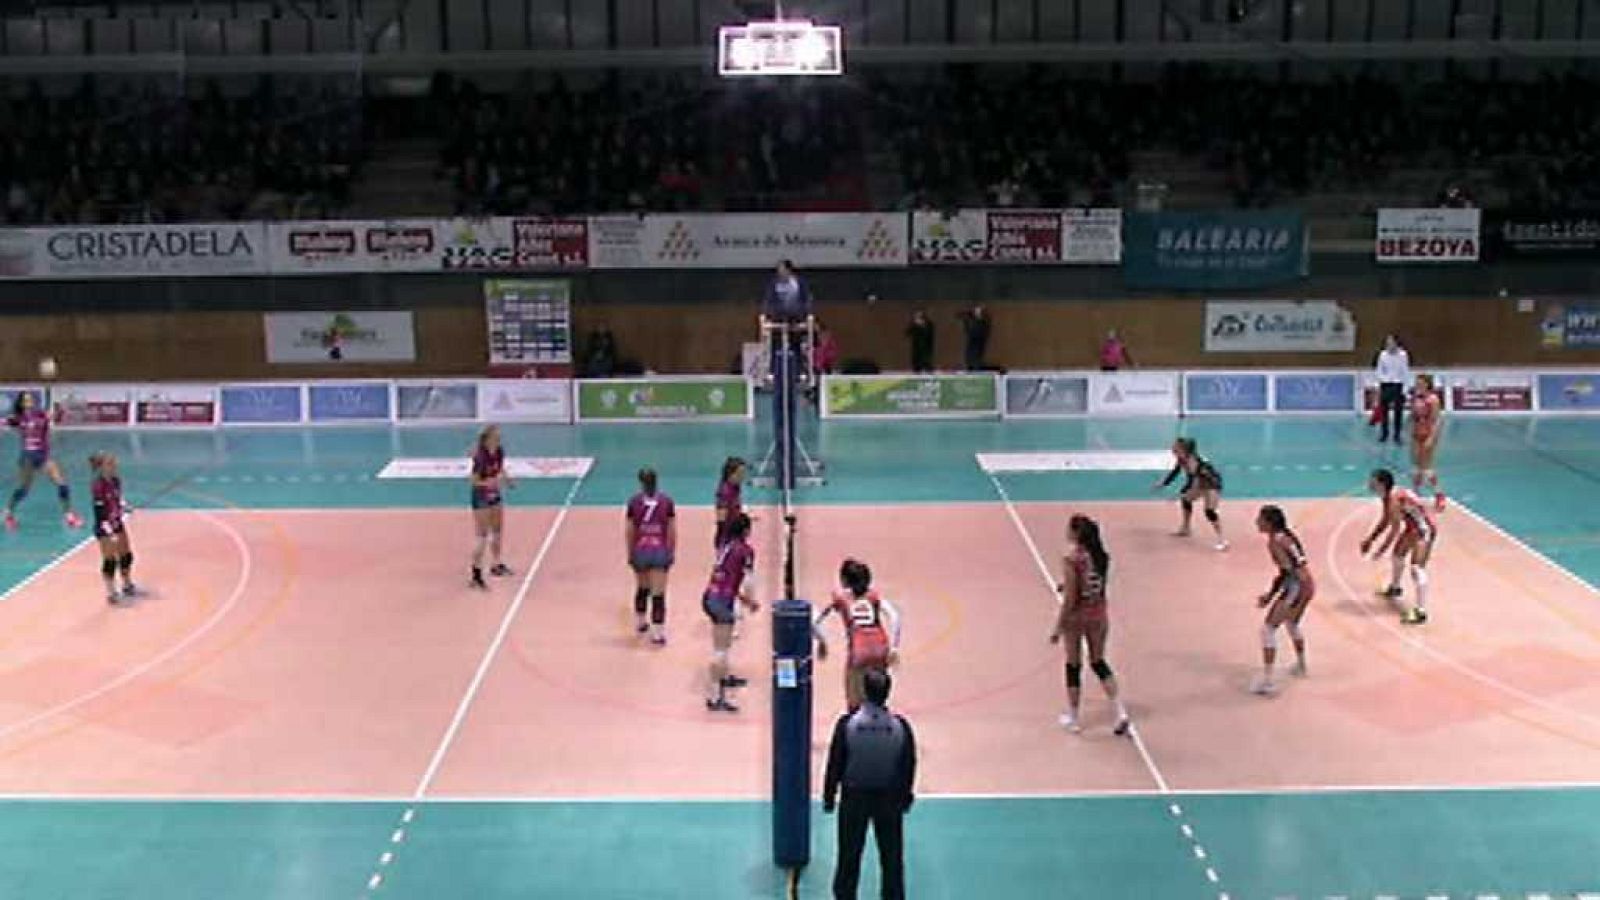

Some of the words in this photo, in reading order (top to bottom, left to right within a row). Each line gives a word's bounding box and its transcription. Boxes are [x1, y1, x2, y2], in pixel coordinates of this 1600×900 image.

[47, 230, 253, 261] CRISTADELA
[1377, 238, 1476, 257] BEZOYA
[643, 500, 659, 522] 7
[851, 600, 875, 625] 9
